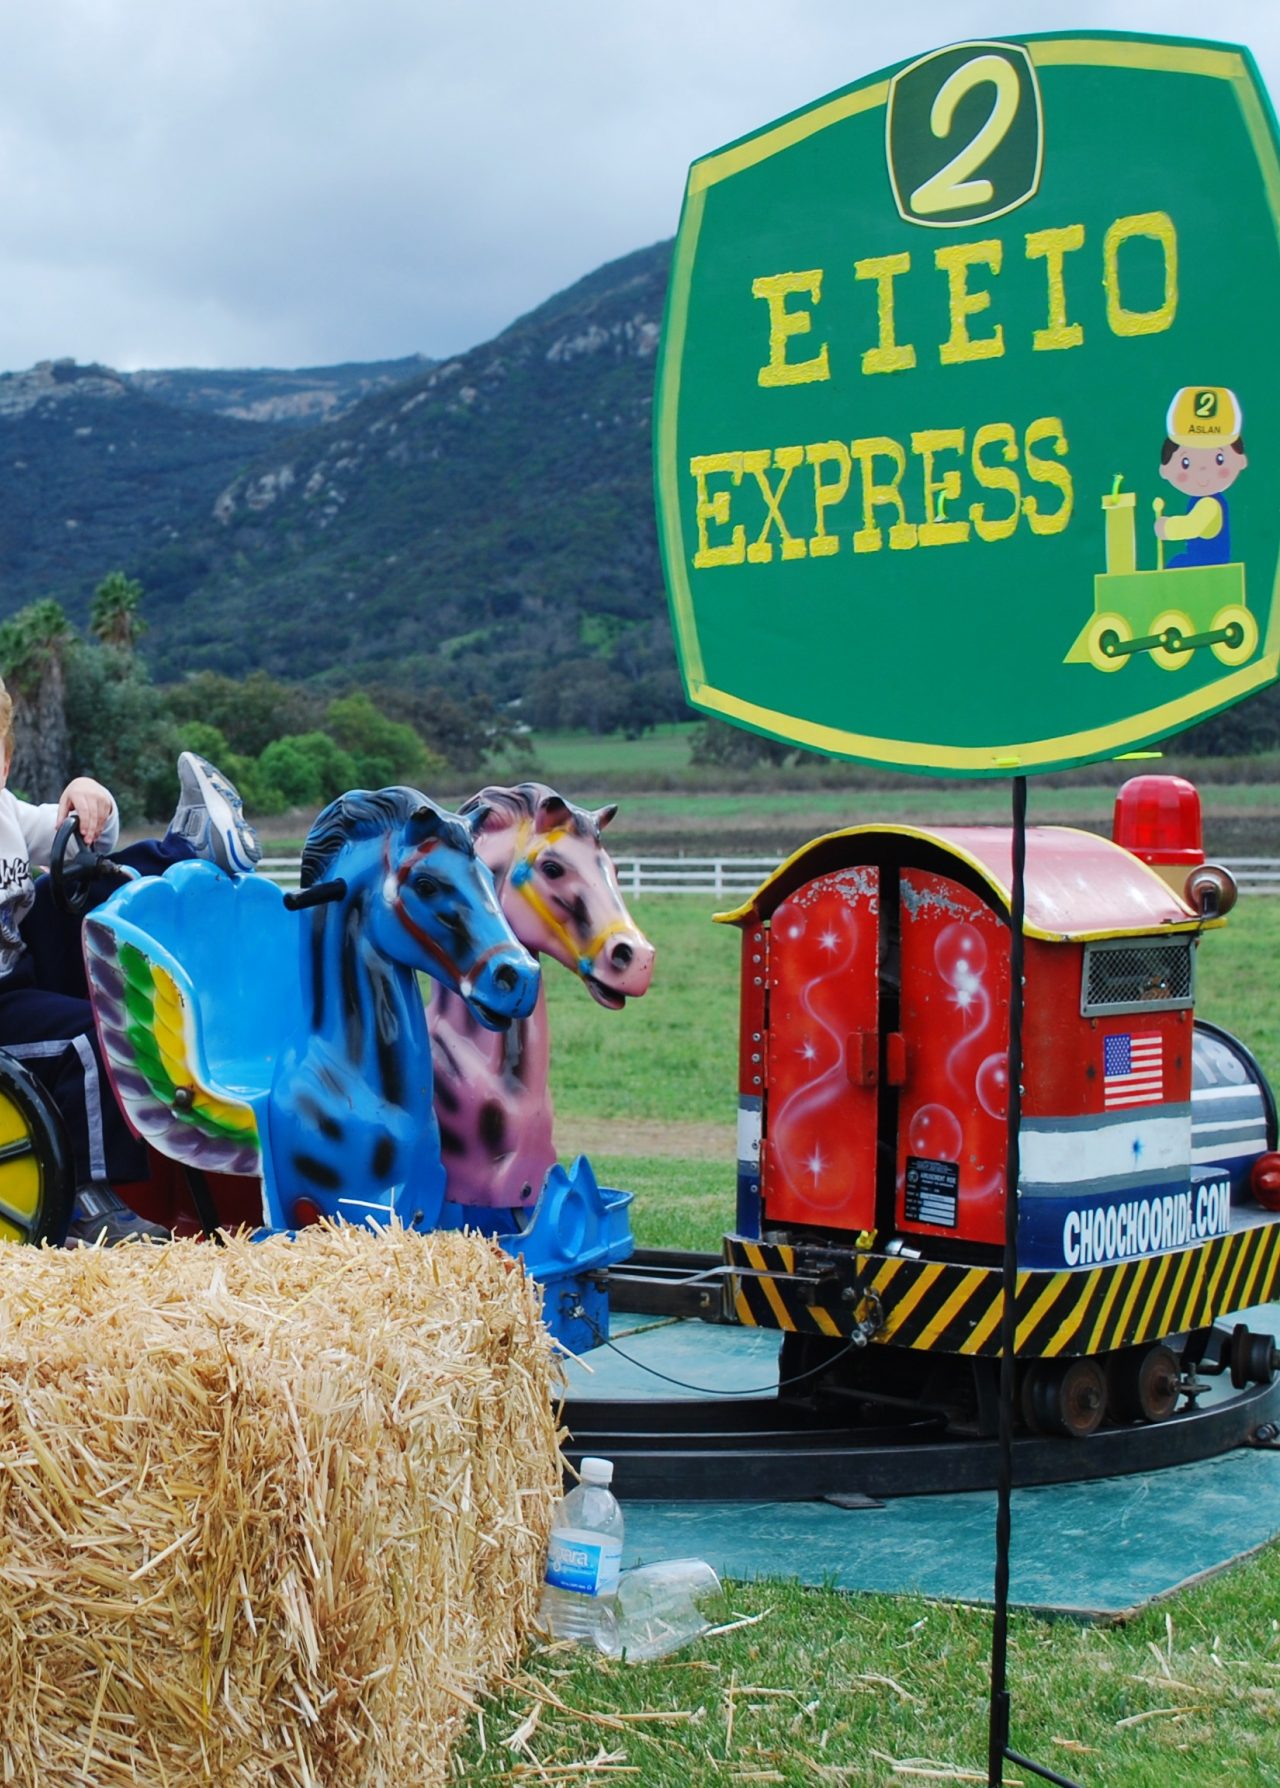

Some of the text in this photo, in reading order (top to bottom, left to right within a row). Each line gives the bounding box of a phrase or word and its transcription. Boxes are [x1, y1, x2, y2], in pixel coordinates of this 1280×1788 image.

[910, 54, 1020, 214] 2
[1196, 393, 1215, 416] 2
[690, 416, 1074, 569] EXPRESS
